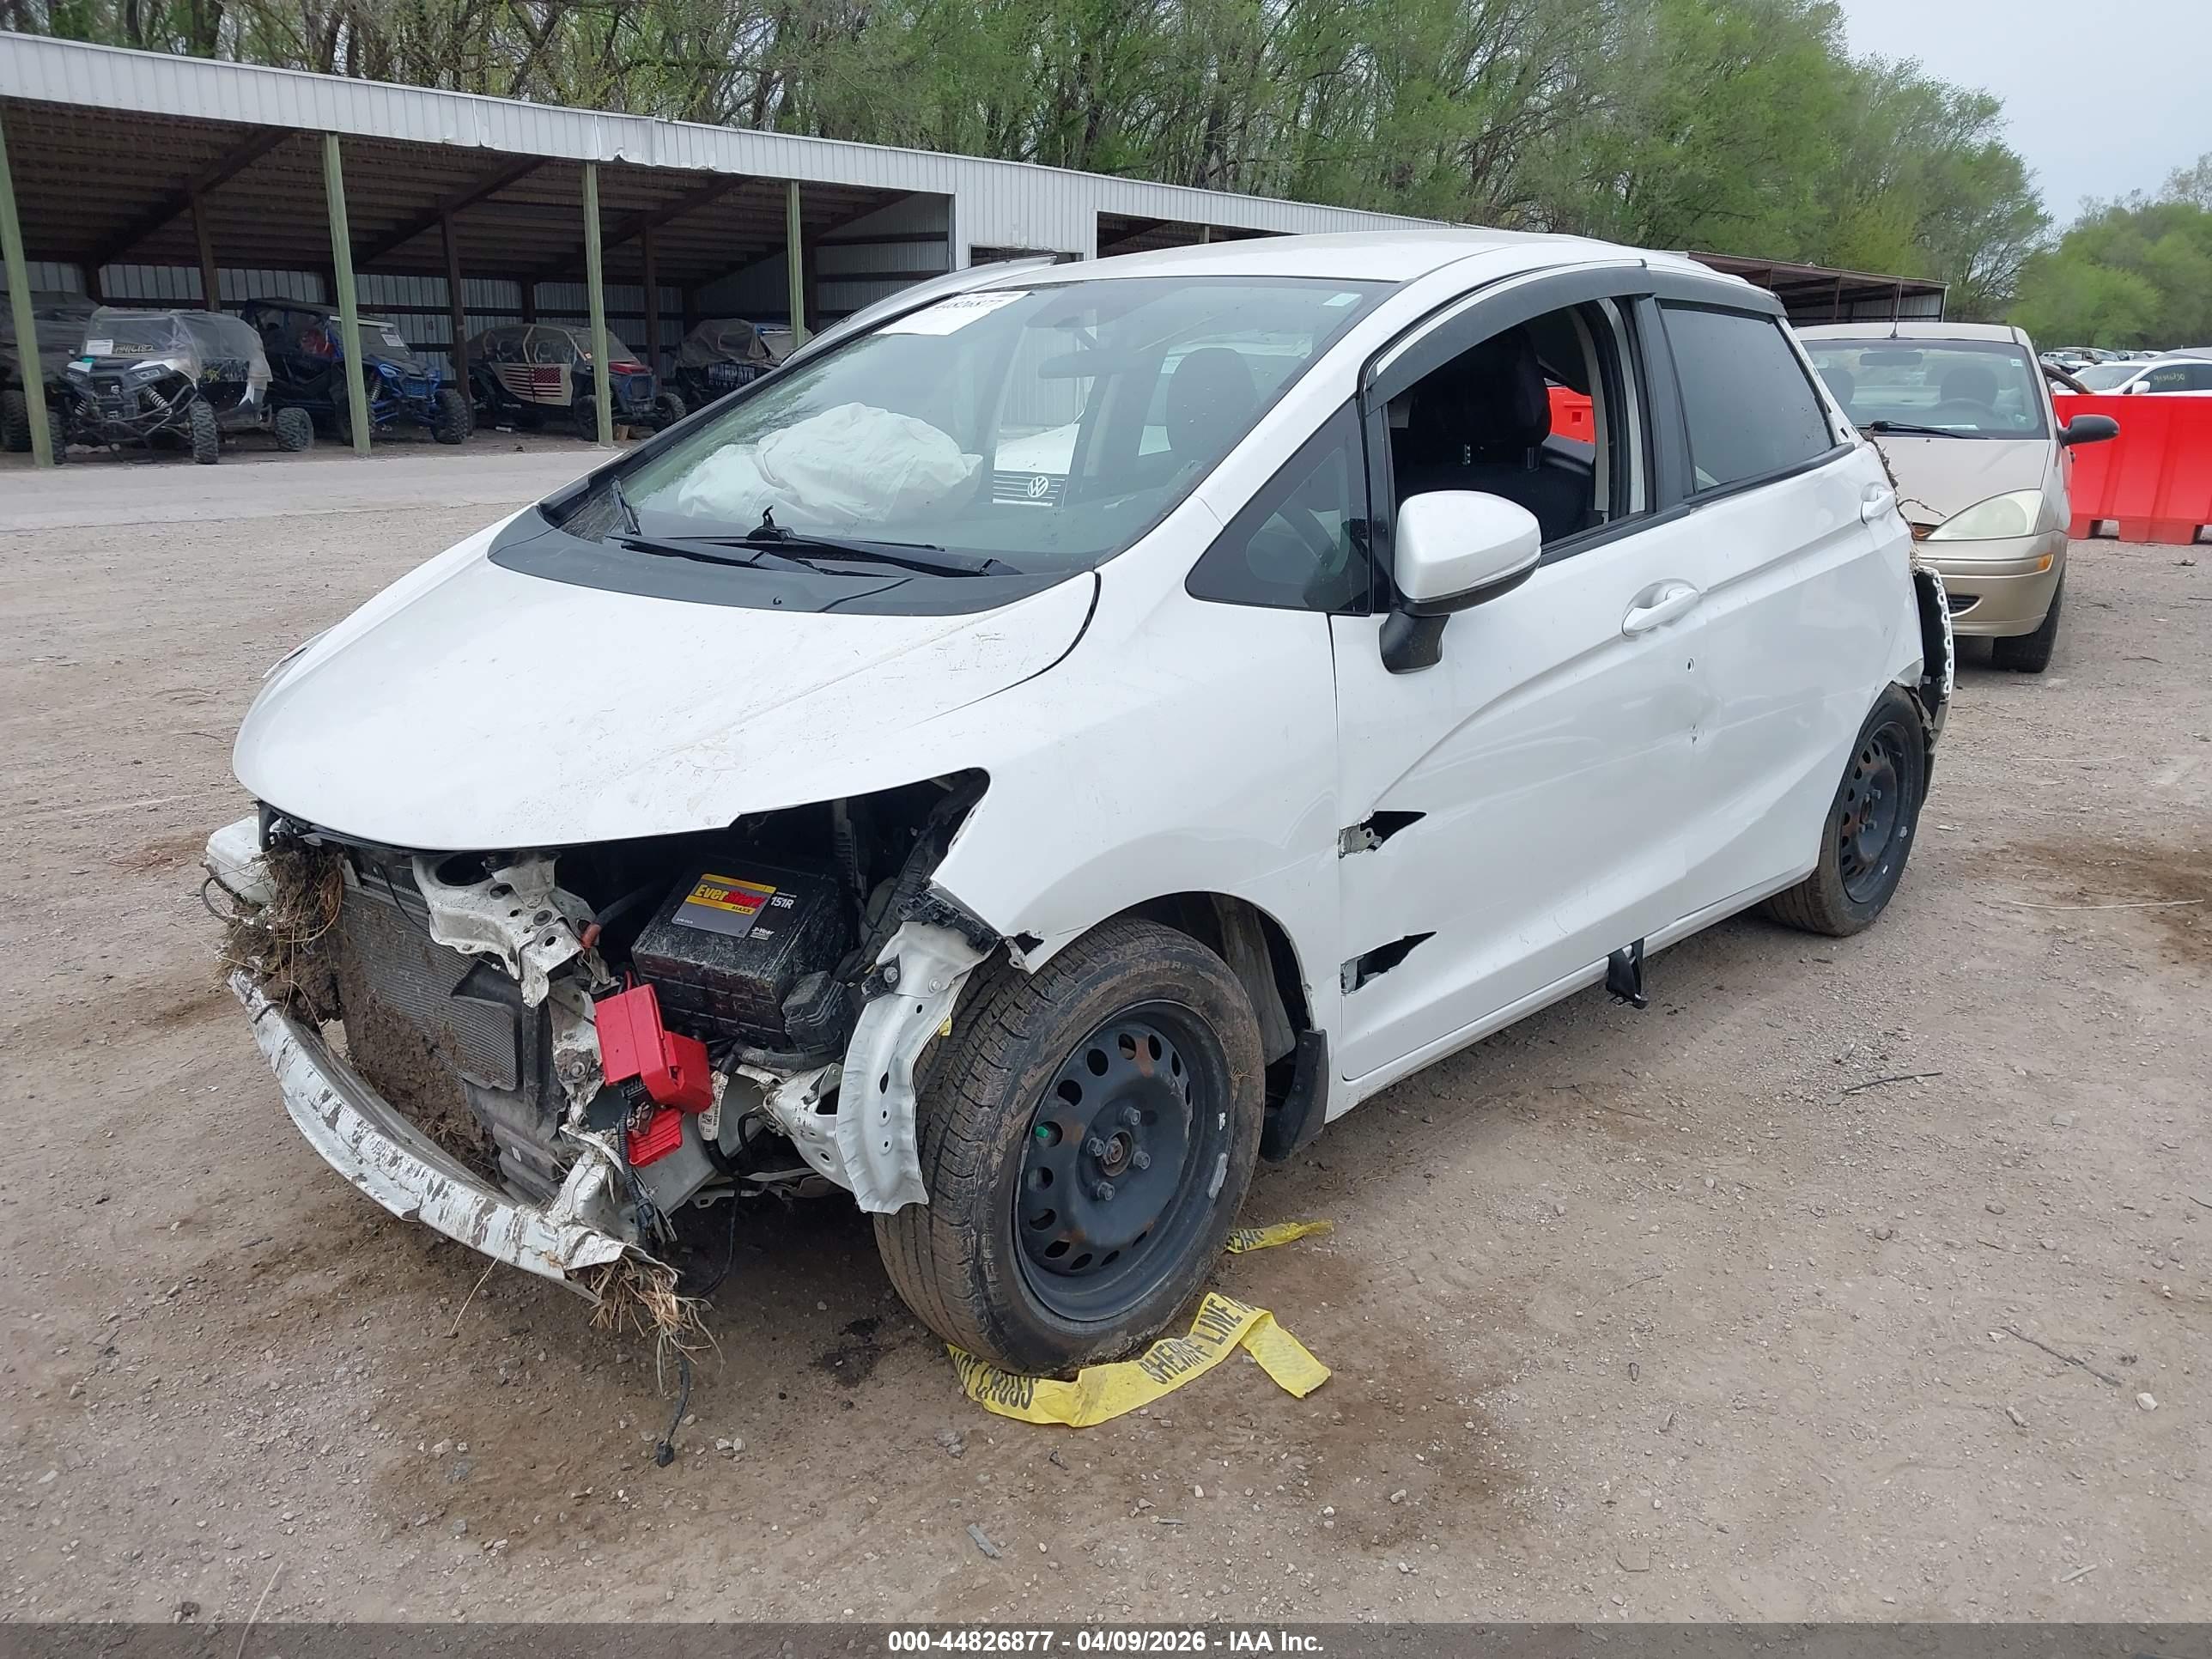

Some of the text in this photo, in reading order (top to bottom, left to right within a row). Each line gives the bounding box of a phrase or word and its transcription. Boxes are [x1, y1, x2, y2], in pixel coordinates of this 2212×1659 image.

[771, 896, 795, 909] 151R
[731, 905, 751, 914] MAXX
[1192, 1297, 1244, 1346] LINE
